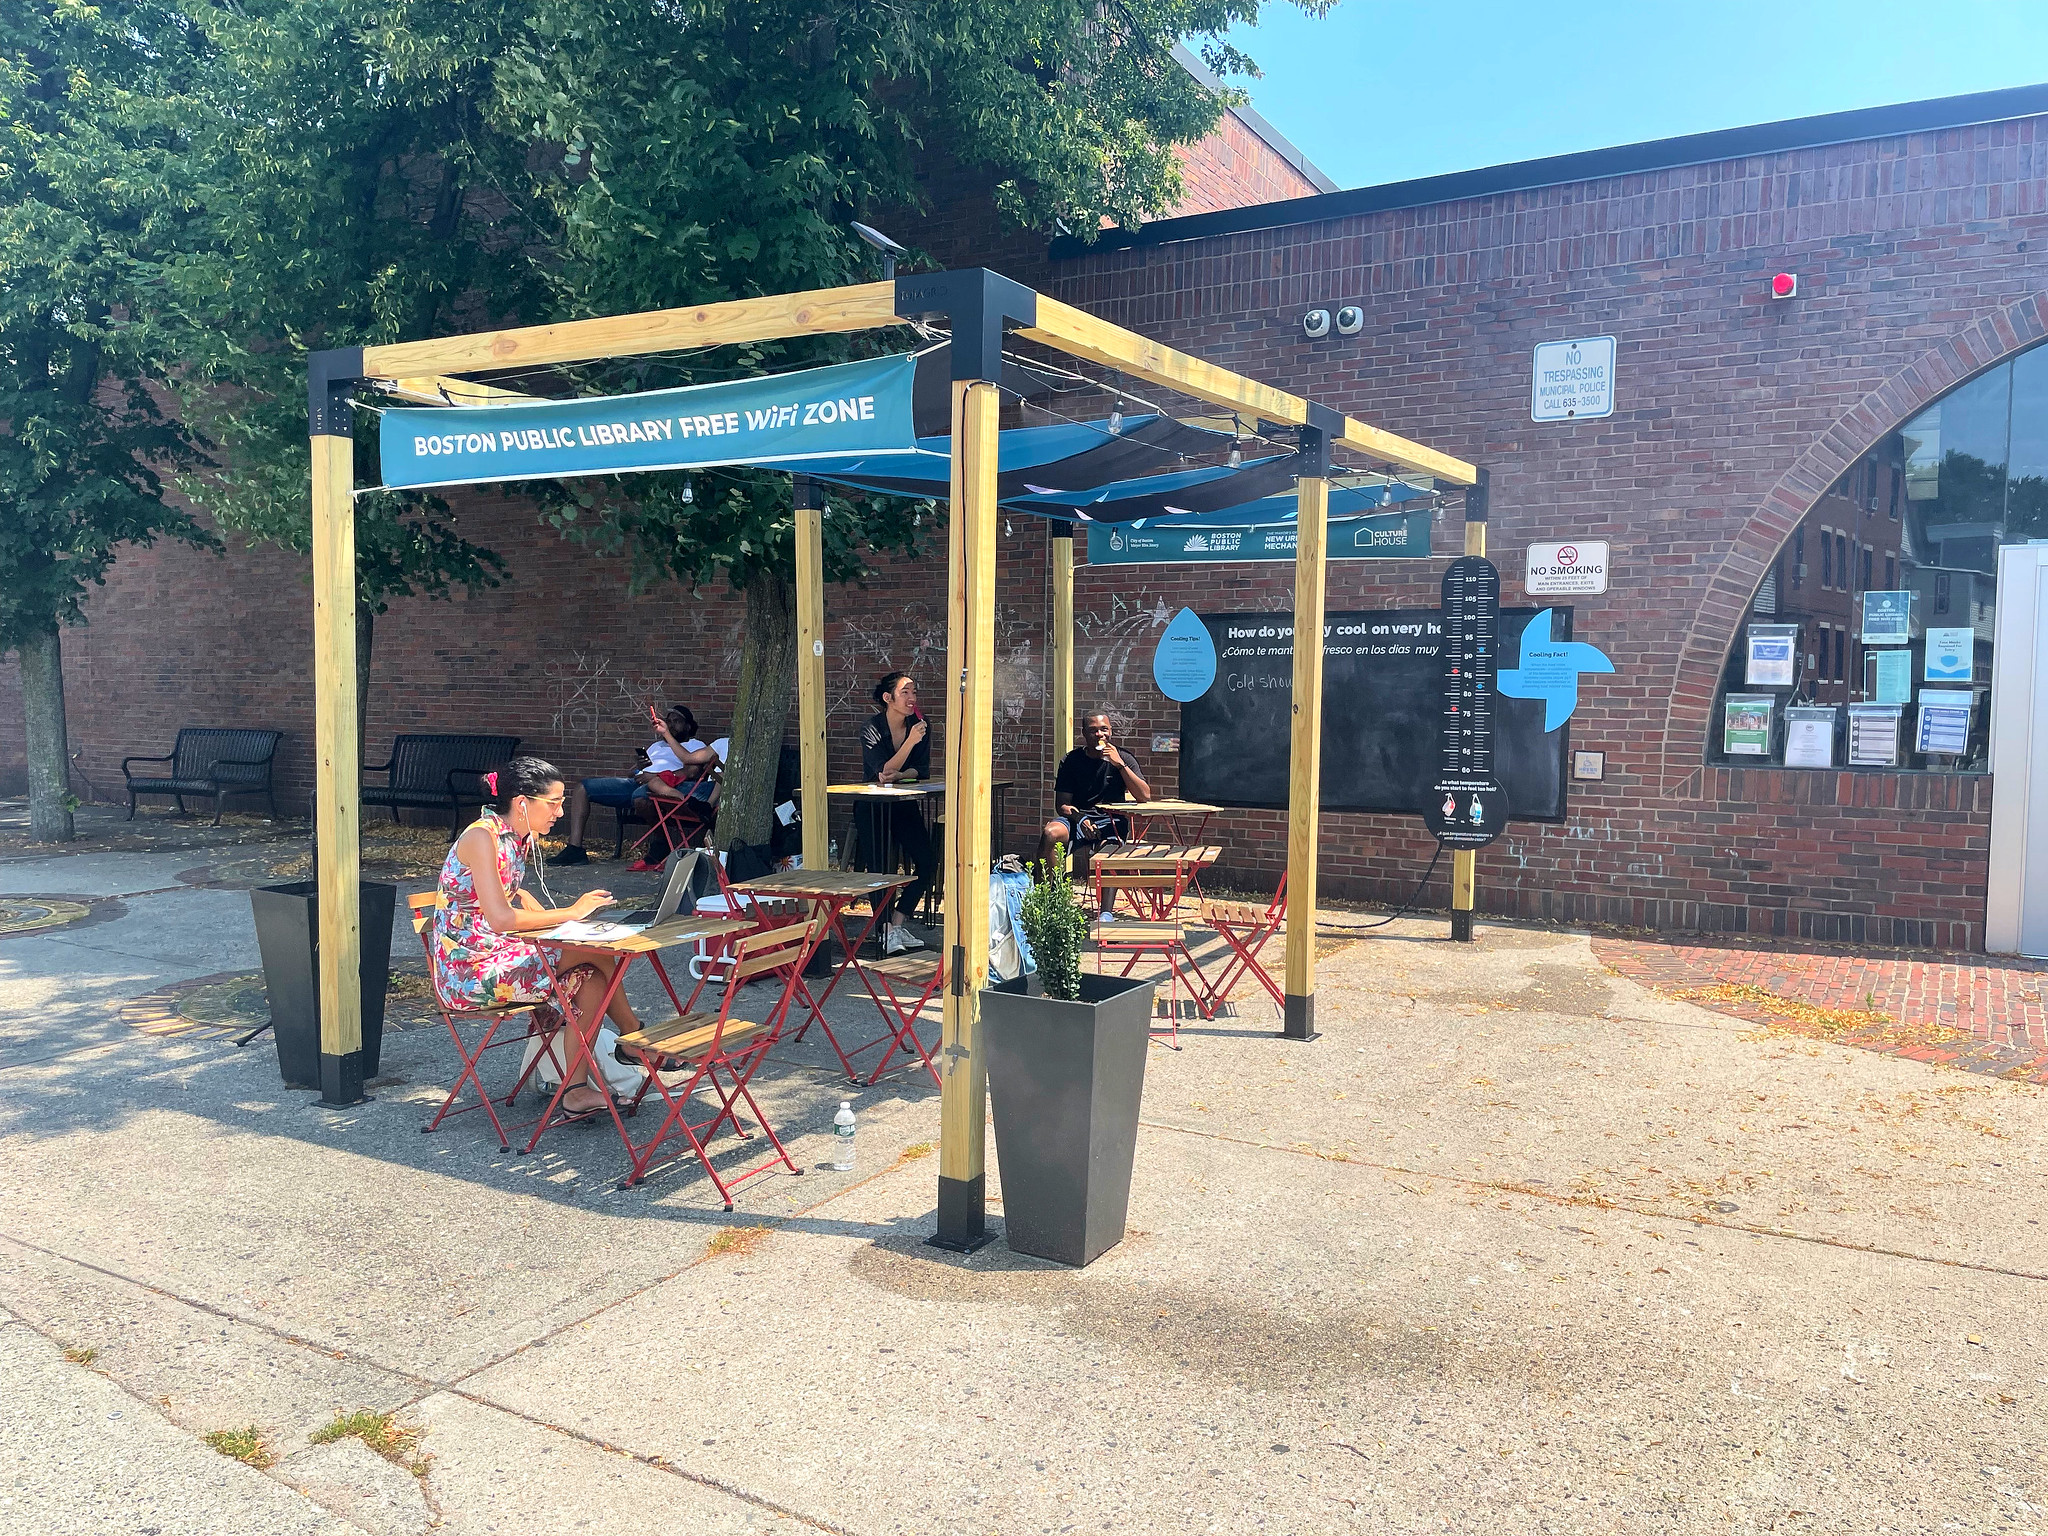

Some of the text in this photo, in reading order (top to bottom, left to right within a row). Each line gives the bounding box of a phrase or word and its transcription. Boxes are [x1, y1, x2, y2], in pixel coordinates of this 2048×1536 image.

[1566, 350, 1581, 365] NO
[1544, 366, 1603, 383] TRESPASSING
[1540, 381, 1605, 396] MUNICIPAL POLICE
[1544, 399, 1561, 409] CALL
[414, 396, 874, 456] BOSTON PUBLIC LIBRARY FREE WiFi ZONE
[1265, 535, 1284, 543] NEW
[1374, 530, 1408, 538] CULTURE
[1264, 542, 1298, 550] MECHAN
[1374, 537, 1407, 546] HOUSE
[1531, 565, 1603, 575] NO SMOKING
[1228, 627, 1256, 639] How
[1258, 626, 1275, 637] do
[1336, 623, 1367, 635] cool
[1371, 625, 1389, 634] on
[1391, 624, 1422, 637] very
[1222, 646, 1254, 658] ¿Cómo
[1257, 646, 1266, 655] te
[1323, 645, 1352, 656] fresco
[1356, 646, 1368, 655] en
[1371, 645, 1386, 655] los
[1415, 646, 1439, 656] muy
[1227, 673, 1254, 691] Cold
